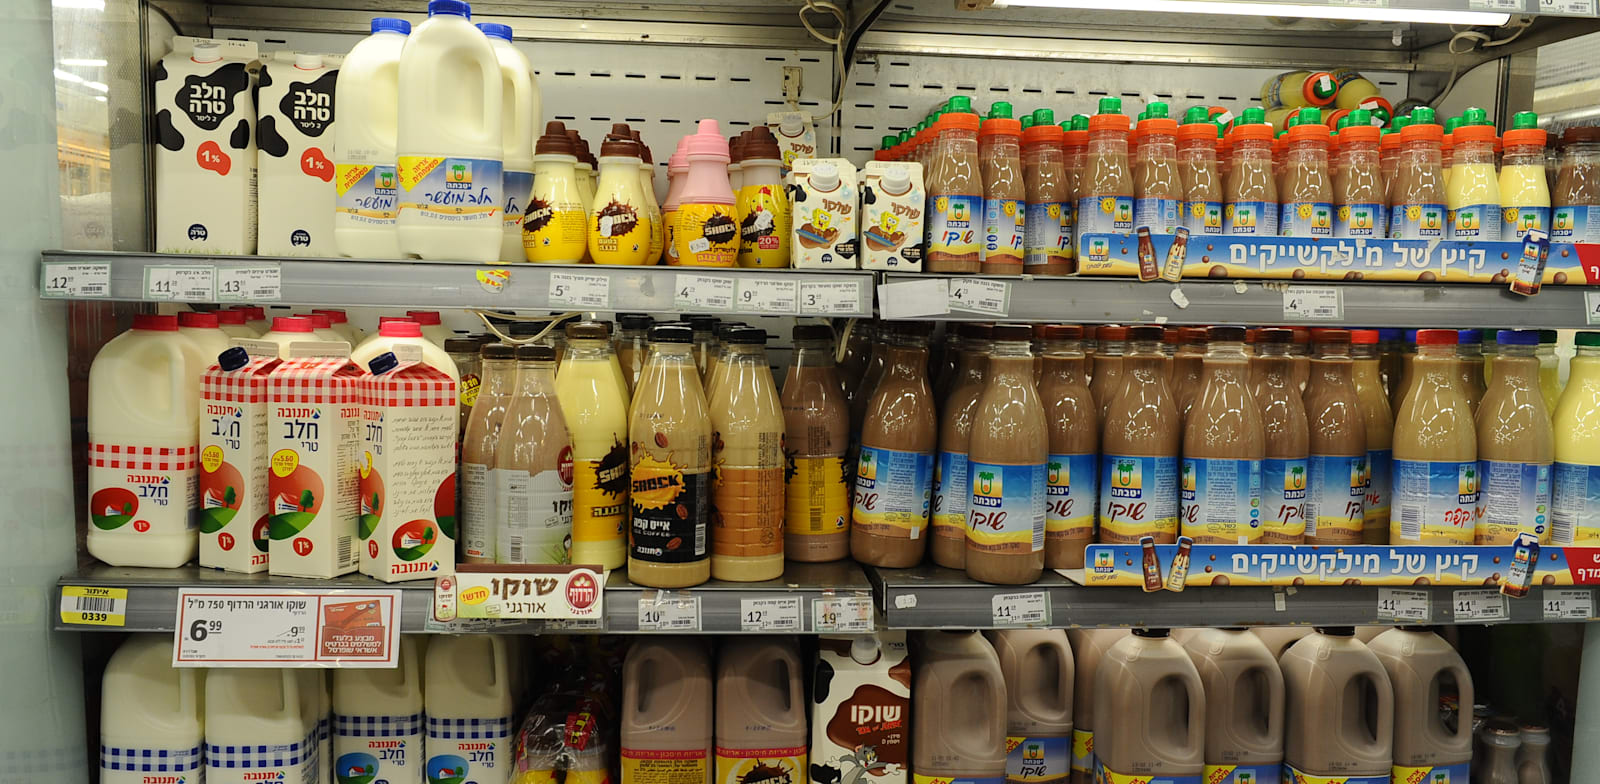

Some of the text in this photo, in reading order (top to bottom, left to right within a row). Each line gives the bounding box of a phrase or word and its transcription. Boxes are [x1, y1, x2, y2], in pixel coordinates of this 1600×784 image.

[190, 82, 225, 99] חלב
[294, 91, 330, 106] חלב
[189, 100, 226, 114] טרה
[294, 107, 330, 121] טרה
[790, 143, 814, 156] שוקו
[201, 150, 220, 164] 1%
[305, 157, 324, 171] 1%
[412, 158, 428, 174] אריזה
[412, 159, 439, 183] משפחתית
[425, 187, 493, 205] חלב מועשר
[355, 196, 393, 210] מועשר
[504, 197, 519, 213] חל
[822, 198, 852, 215] שוקו
[891, 202, 921, 220] שוקו
[704, 223, 736, 236] SHOCK
[1455, 229, 1479, 237] יטבתה
[759, 237, 779, 245] 20%
[941, 230, 975, 247] שוקו
[1229, 240, 1486, 277] קיץ של מילקשייקים
[51, 277, 67, 289] 12
[155, 280, 171, 292] 11
[225, 280, 240, 292] 13
[555, 285, 564, 297] 5
[680, 287, 689, 299] 4
[743, 290, 752, 303] 9
[954, 288, 962, 299] 4
[807, 294, 816, 306] 3
[1289, 299, 1297, 310] 4
[277, 407, 310, 418] תנובה
[340, 407, 360, 418] נובה
[363, 409, 380, 421] תנובה
[283, 419, 318, 440] חלב
[365, 422, 383, 443] חלב
[225, 438, 240, 450] טרי
[301, 441, 319, 452] טרי
[127, 475, 160, 484] תנובה
[599, 463, 626, 484] SHO
[632, 475, 680, 493] SHOCK
[139, 484, 168, 498] חלב
[1111, 488, 1141, 498] יטבתה
[153, 498, 168, 506] טרי
[973, 495, 1002, 508] יטבתה
[1365, 490, 1380, 506] איי
[552, 500, 573, 516] וקו
[1107, 501, 1148, 523] שוקו
[969, 508, 1008, 531] שוקו
[1444, 507, 1470, 528] קפה
[633, 518, 670, 531] אייס קפה
[221, 535, 232, 548] 1%
[297, 541, 309, 553] 1%
[636, 546, 655, 555] תנובה
[251, 552, 269, 565] ובה
[391, 561, 428, 575] תנובה
[1231, 549, 1479, 582] קיץ של מילקשייקים
[462, 577, 559, 603] חדש! שוקו
[569, 587, 593, 605] הרדוף
[188, 597, 306, 612] שוקו אורגני הרדוף 750 מ"ל
[506, 602, 546, 614] אורגני
[569, 607, 593, 615] אורגני
[997, 605, 1011, 617] 11
[1382, 599, 1395, 610] 11
[1458, 601, 1472, 612] 11
[1548, 600, 1561, 612] 11
[82, 612, 108, 622] 0339
[645, 611, 660, 623] 10
[747, 611, 762, 623] 12
[822, 613, 837, 625] 19
[190, 619, 222, 642] 6 99
[290, 626, 299, 637] 9
[850, 705, 901, 725] שוקו
[368, 740, 397, 748] תנובה
[379, 748, 405, 760] חלב
[469, 750, 494, 762] חלב
[392, 759, 405, 767] טרי
[243, 771, 275, 780] תנובה
[1020, 765, 1048, 779] שוקו
